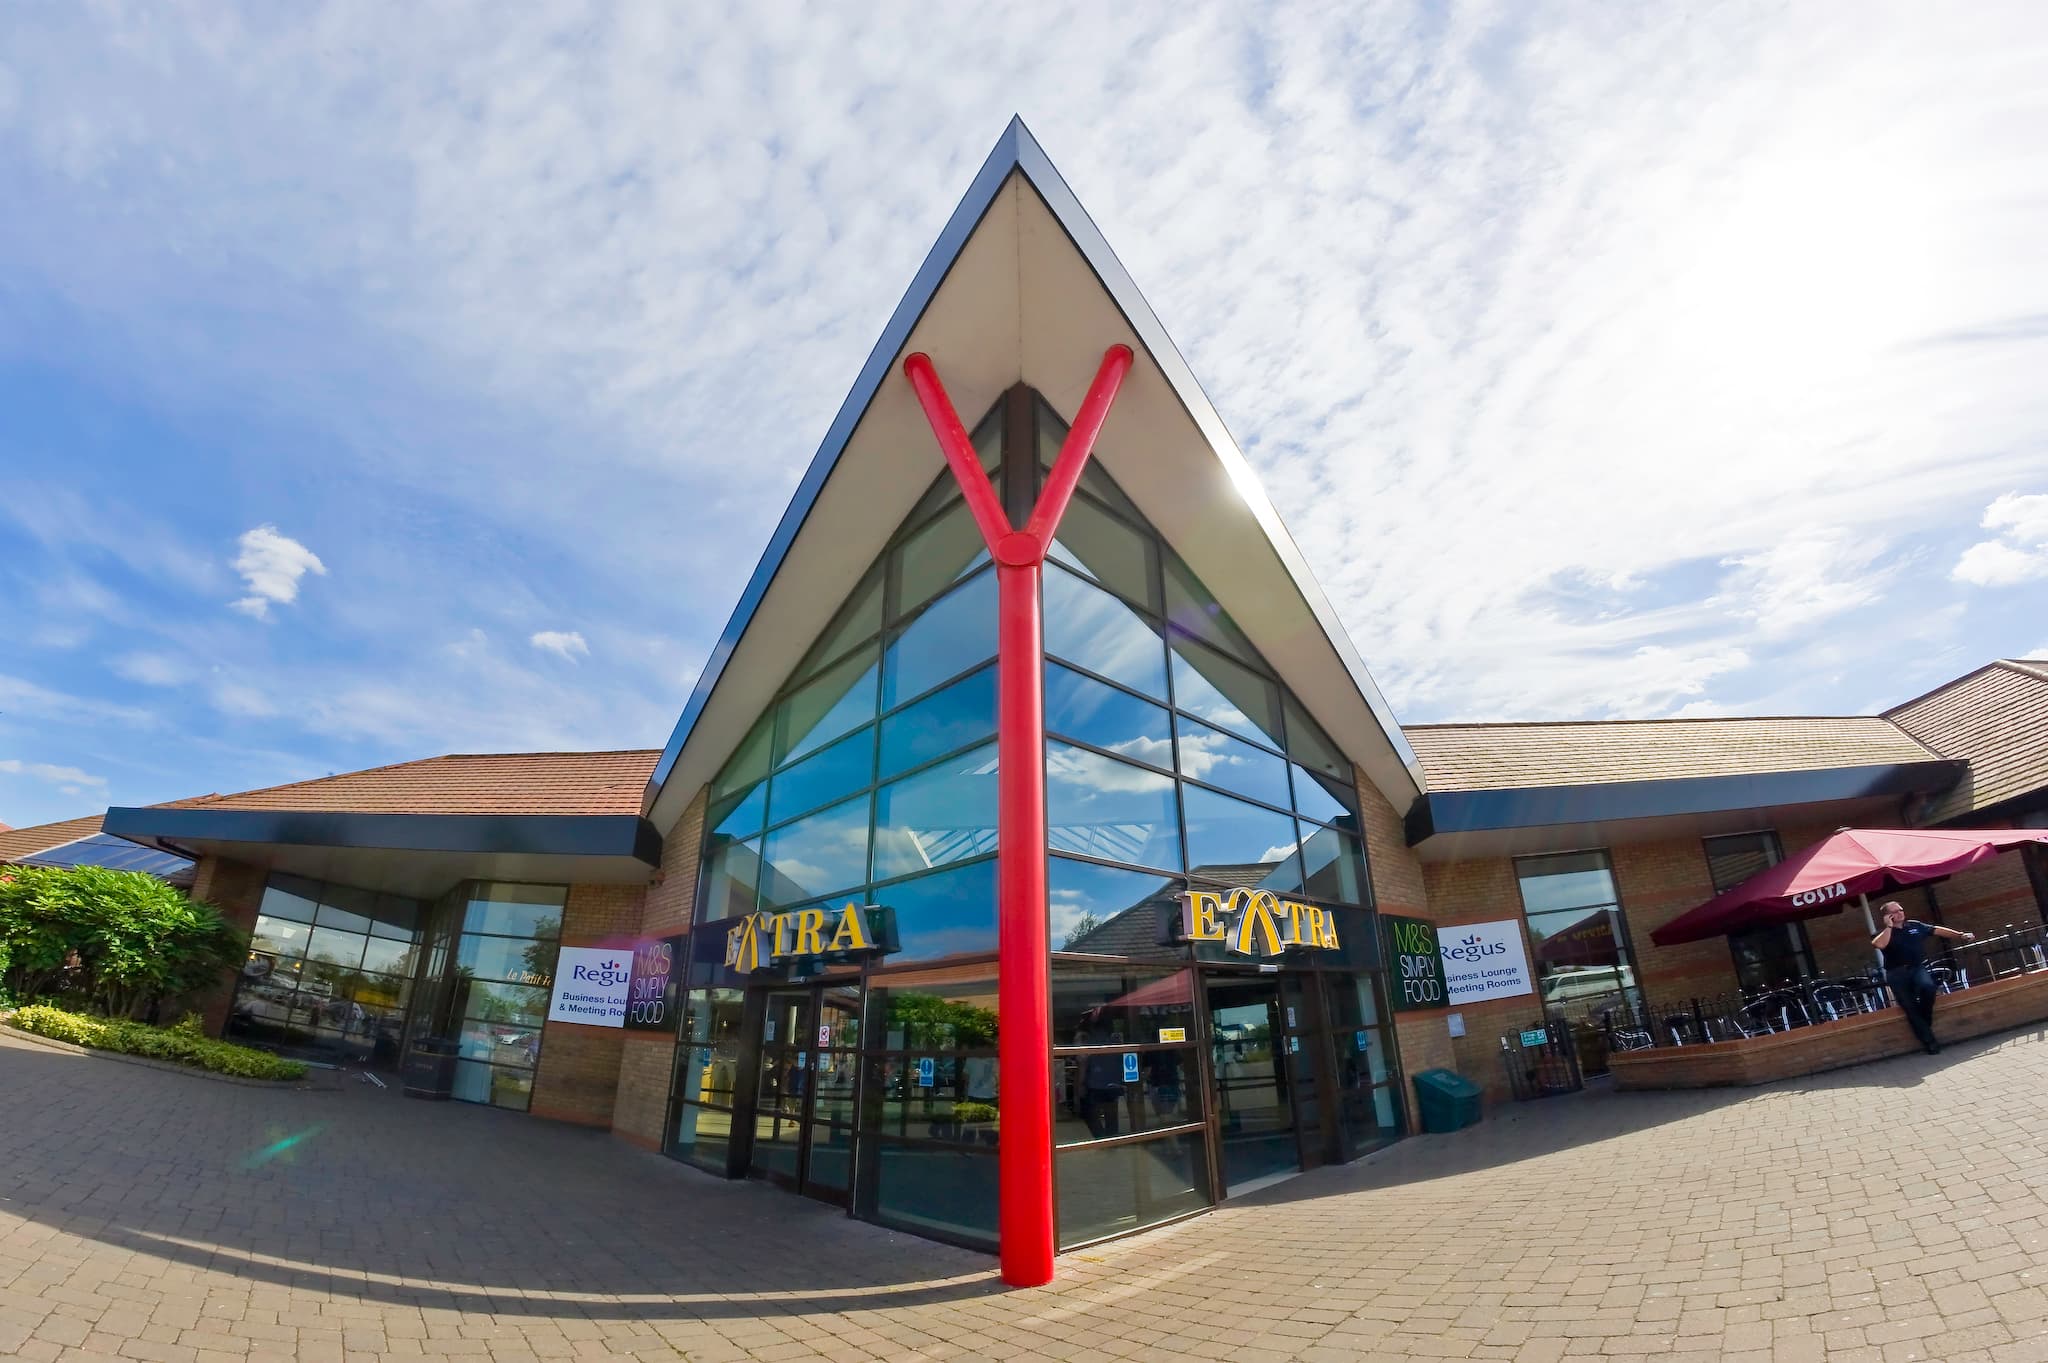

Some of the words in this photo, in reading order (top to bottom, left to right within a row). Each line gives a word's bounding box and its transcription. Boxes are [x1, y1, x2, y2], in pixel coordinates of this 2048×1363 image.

[1792, 882, 1847, 907] COSTA
[1184, 887, 1340, 956] EXTRA
[724, 902, 870, 974] EXTRA
[1394, 922, 1433, 955] M&S
[637, 943, 673, 976] M&S
[1440, 942, 1506, 963] Regus
[1400, 954, 1436, 978] SIMPLY
[1481, 967, 1518, 979] Lounge
[634, 976, 670, 1000] SIMPLY
[1404, 979, 1441, 1003] FOOD
[1487, 977, 1521, 990] Rooms
[559, 1003, 566, 1012] &
[568, 1004, 606, 1017] Meeting
[562, 992, 605, 1004] Business
[630, 1001, 665, 1024] FOOD
